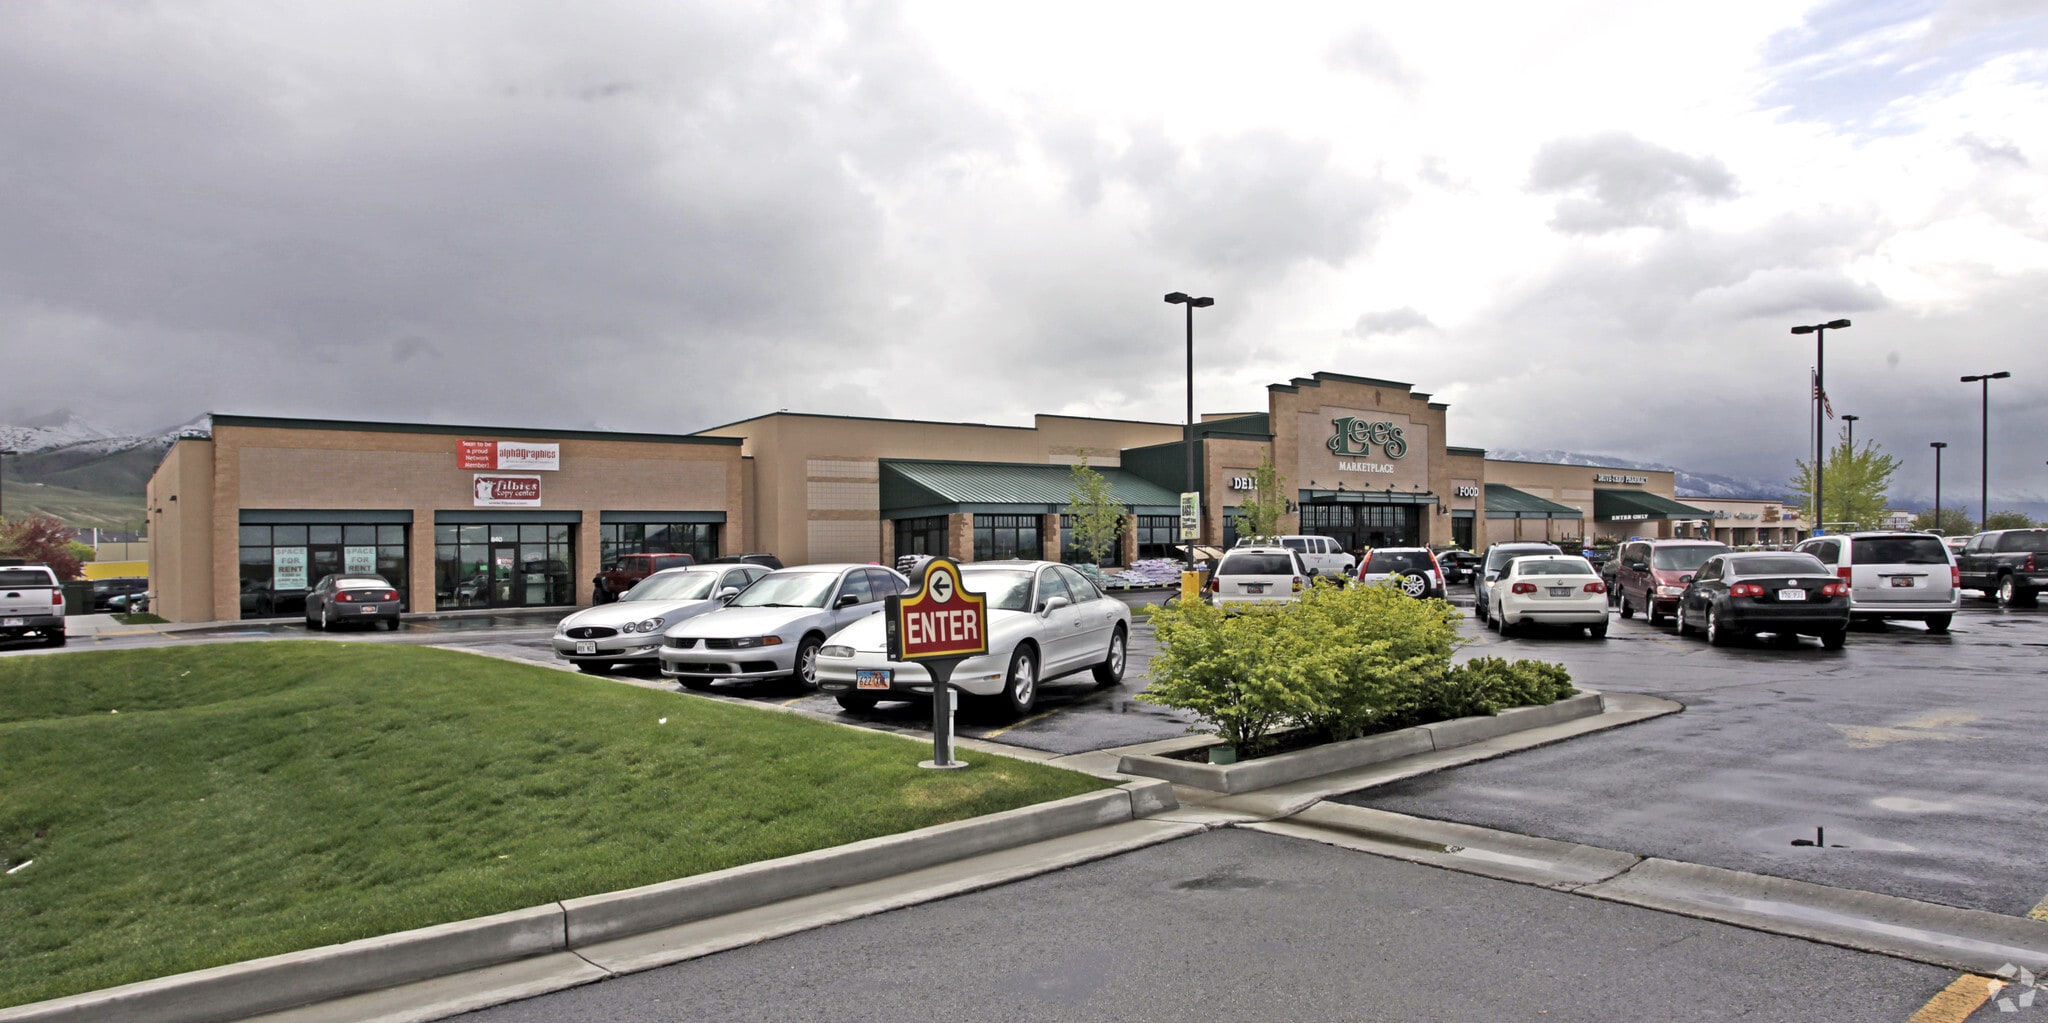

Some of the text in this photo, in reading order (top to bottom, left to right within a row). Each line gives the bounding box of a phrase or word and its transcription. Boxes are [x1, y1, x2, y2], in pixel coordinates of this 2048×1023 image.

[1328, 416, 1409, 459] Lee's
[1339, 461, 1395, 473] MARKETPLACE
[1625, 475, 1648, 484] PHARMACY
[496, 490, 513, 498] copy
[1460, 486, 1479, 497] FOOD
[907, 609, 978, 644] ENTER
